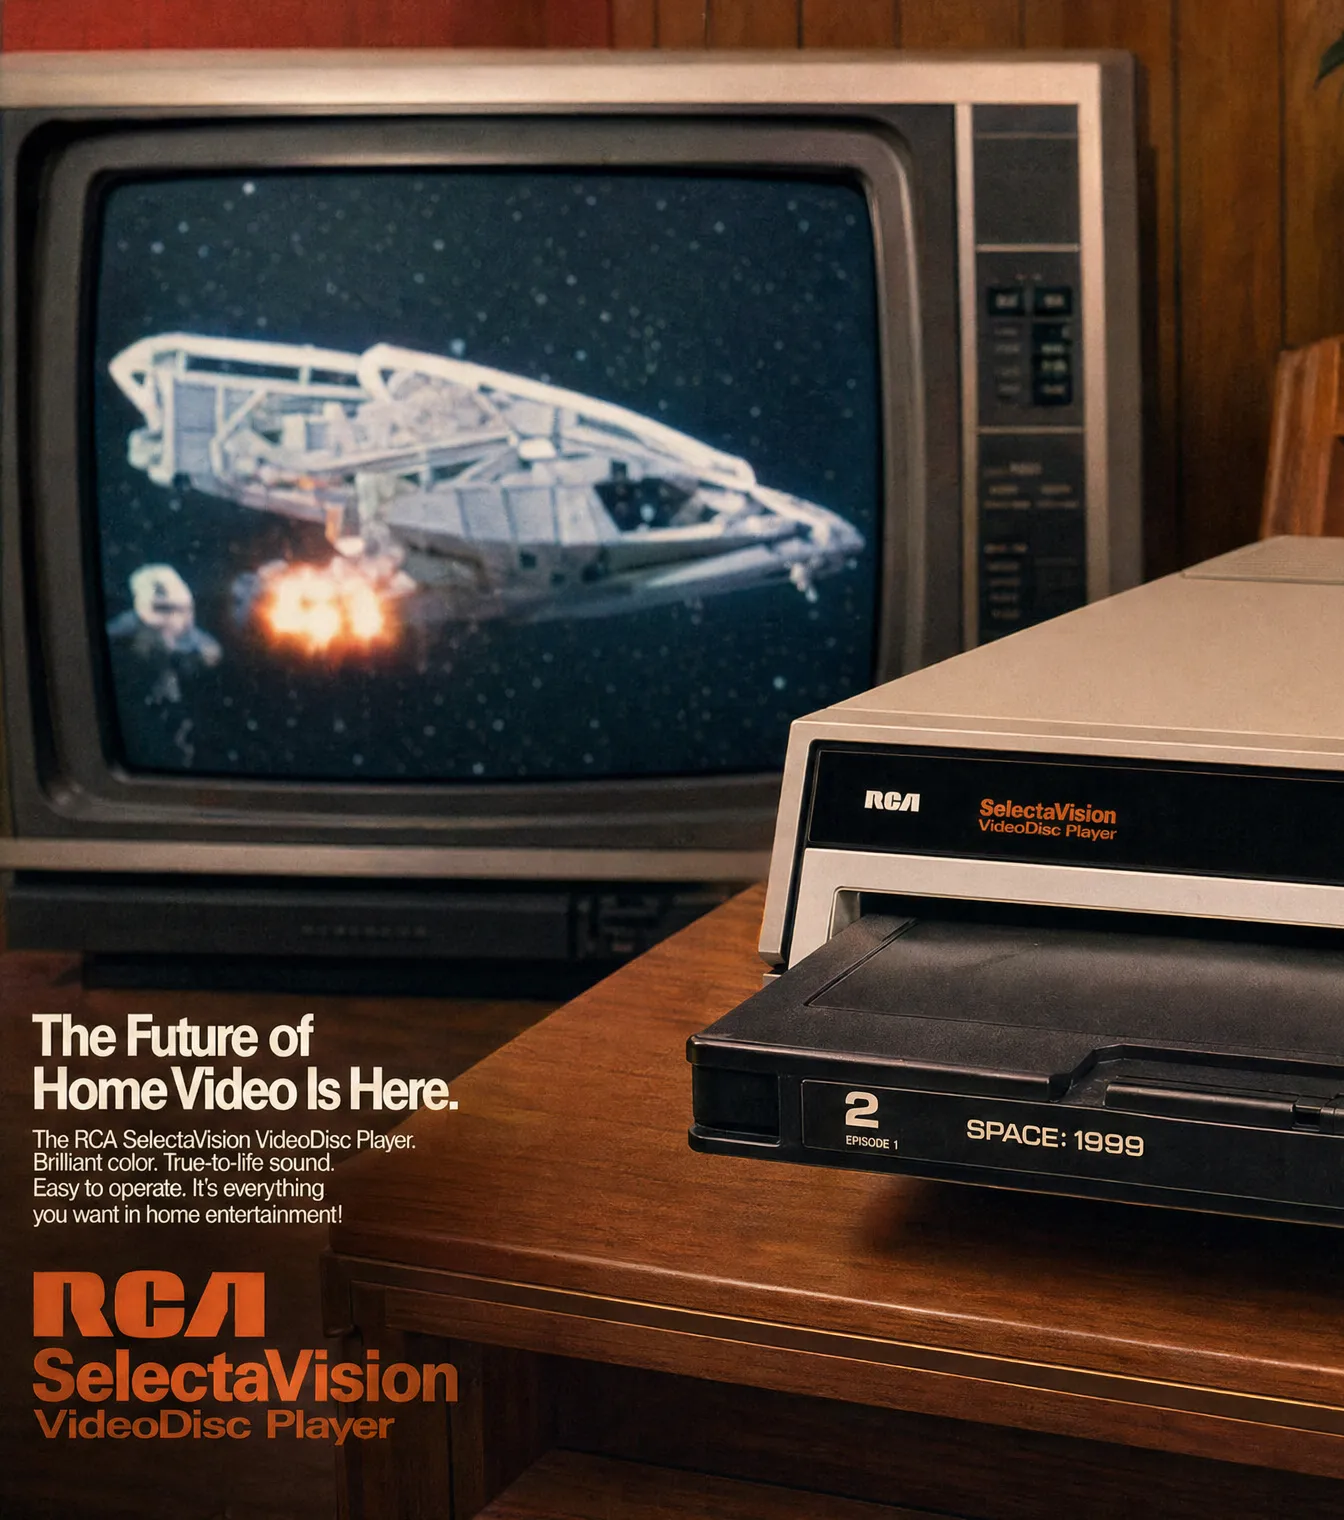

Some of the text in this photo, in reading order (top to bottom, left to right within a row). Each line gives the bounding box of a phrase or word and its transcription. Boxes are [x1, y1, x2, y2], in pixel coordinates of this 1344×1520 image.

[865, 790, 920, 812] RCA
[980, 798, 1116, 824] SelectaVision
[979, 819, 1117, 841] VideoDisc Player
[846, 1092, 878, 1128] 2
[846, 1135, 897, 1149] EPISODE 1
[967, 1120, 1143, 1156] SPACE: 1999
